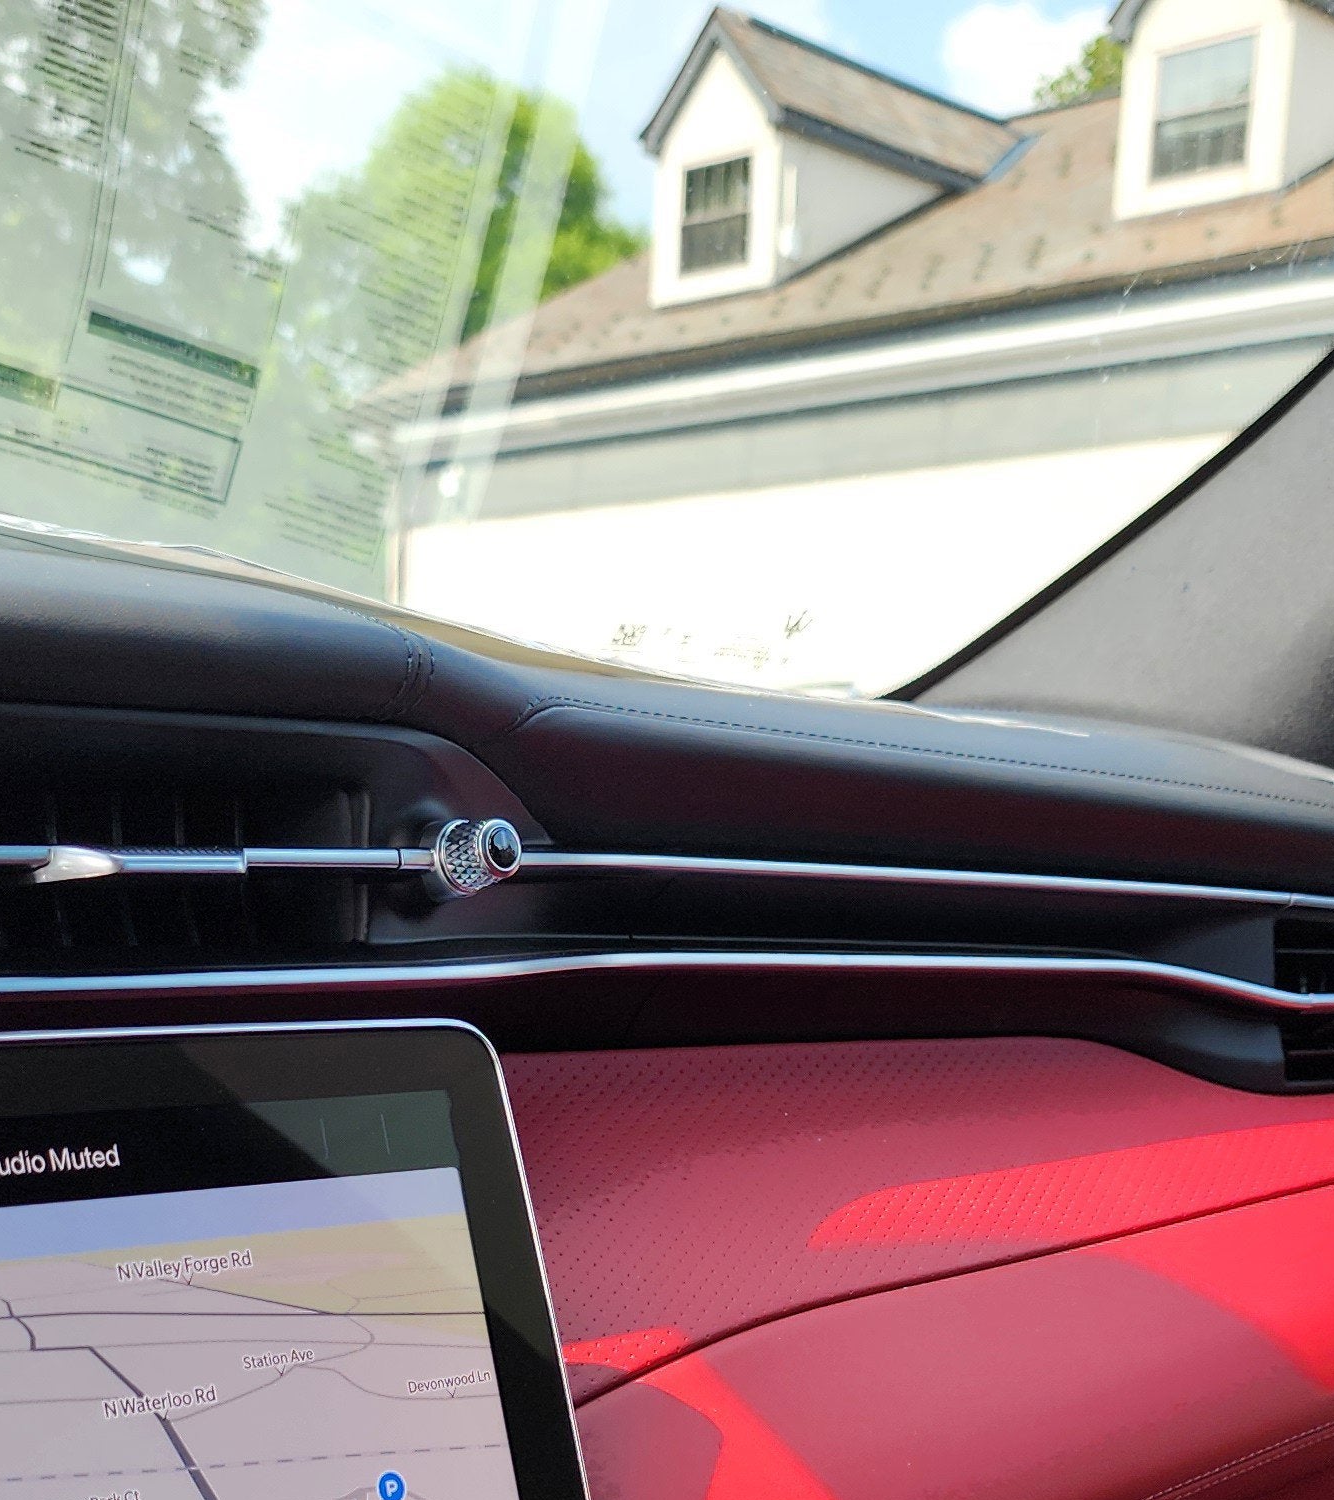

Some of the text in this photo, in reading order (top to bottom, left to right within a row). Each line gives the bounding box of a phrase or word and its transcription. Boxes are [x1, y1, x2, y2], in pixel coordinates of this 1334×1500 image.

[50, 1144, 120, 1172] Muted
[118, 1250, 253, 1282] N Valley Forge Rd
[243, 1348, 315, 1370] Station Ave
[407, 1369, 491, 1394] Devonwood Ln
[103, 1386, 217, 1419] N Waterloo Rd
